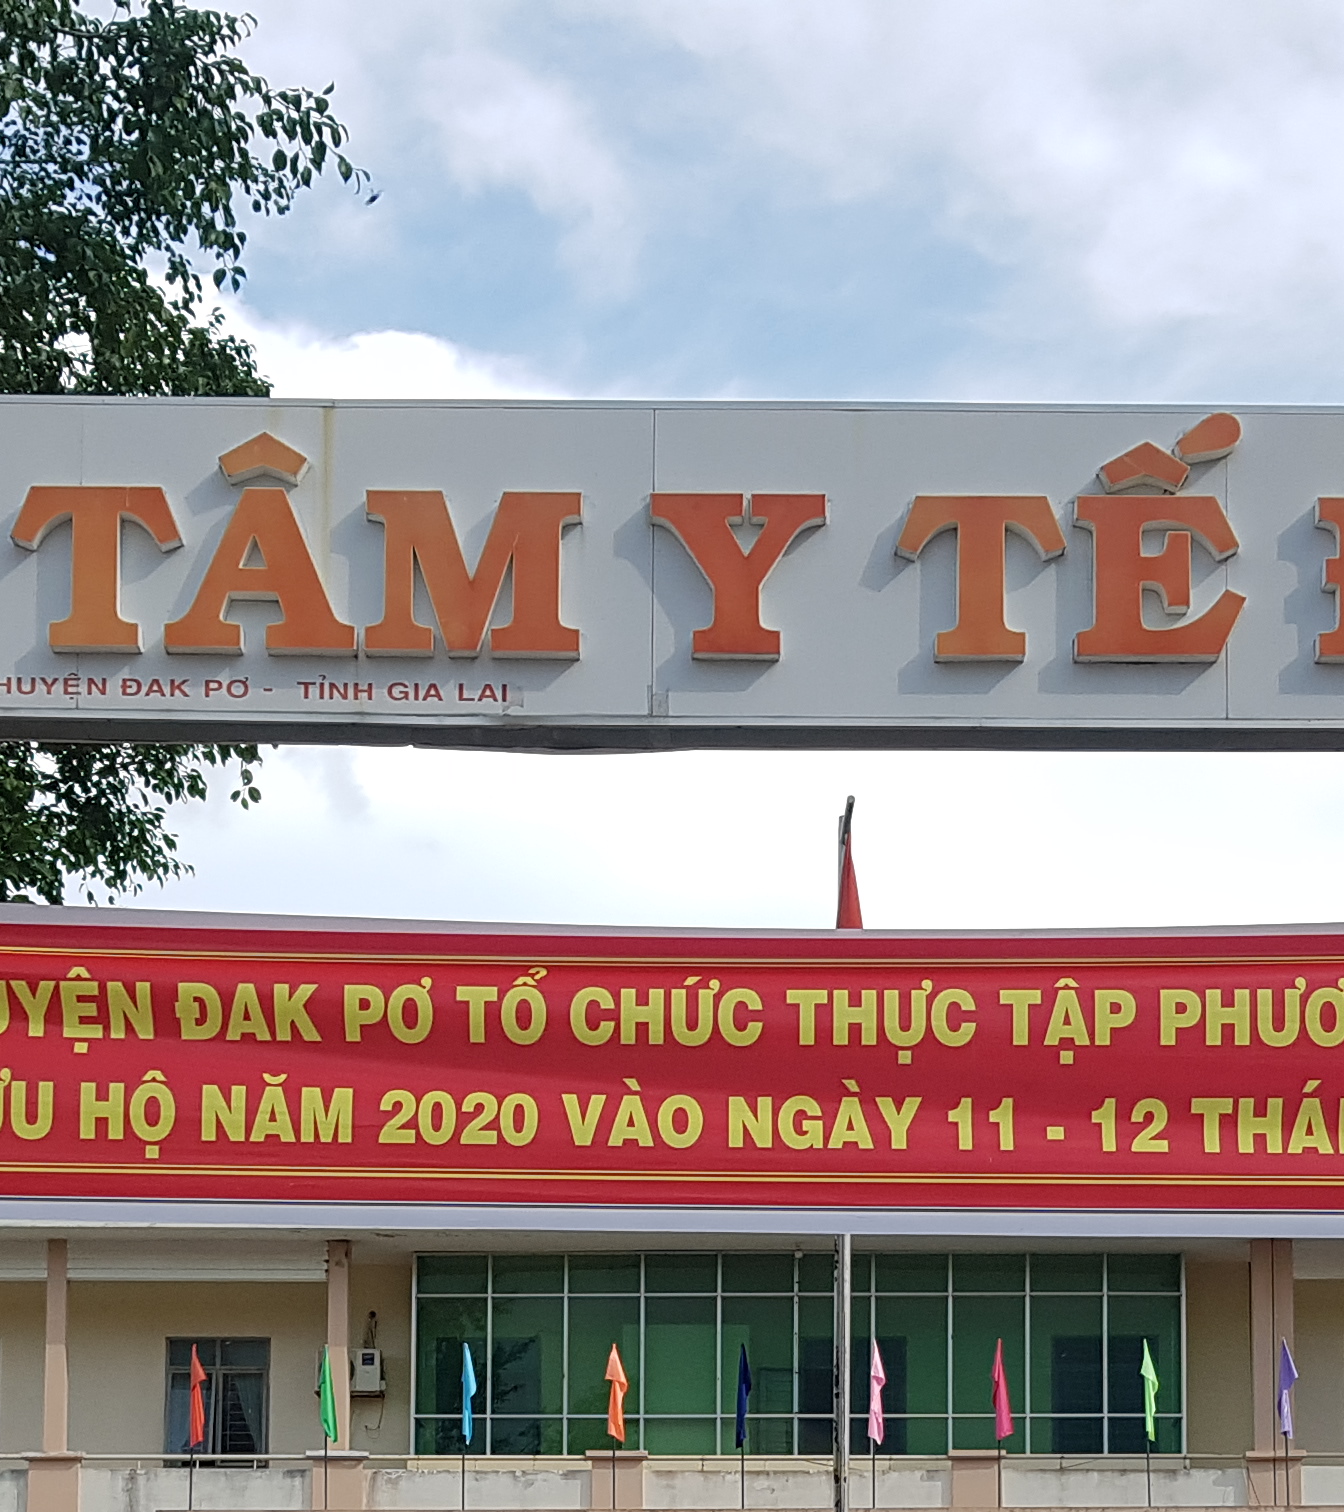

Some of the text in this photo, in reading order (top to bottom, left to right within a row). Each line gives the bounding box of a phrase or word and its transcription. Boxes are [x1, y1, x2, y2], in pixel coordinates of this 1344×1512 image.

[10, 431, 585, 661] TÂM
[649, 492, 828, 662] Y
[895, 412, 1248, 665] TẾ
[119, 676, 191, 698] ĐAK
[203, 674, 251, 699] PƠ
[296, 670, 374, 702] TỈNH
[386, 680, 445, 703] GIA
[457, 681, 509, 704] LAI
[174, 982, 323, 1042] ĐAK
[343, 975, 433, 1044] PƠ
[456, 966, 548, 1047] TỔ
[569, 975, 764, 1047] CHỨC
[786, 978, 978, 1065] THỰC
[999, 976, 1137, 1065] TẬP
[79, 1070, 177, 1159] HỘ
[200, 1072, 354, 1144] NĂM
[377, 1089, 540, 1147] 2020
[561, 1077, 705, 1149] VÀO
[727, 1079, 923, 1150] NGÀY
[947, 1096, 1016, 1152] 11
[1091, 1097, 1170, 1153] 12
